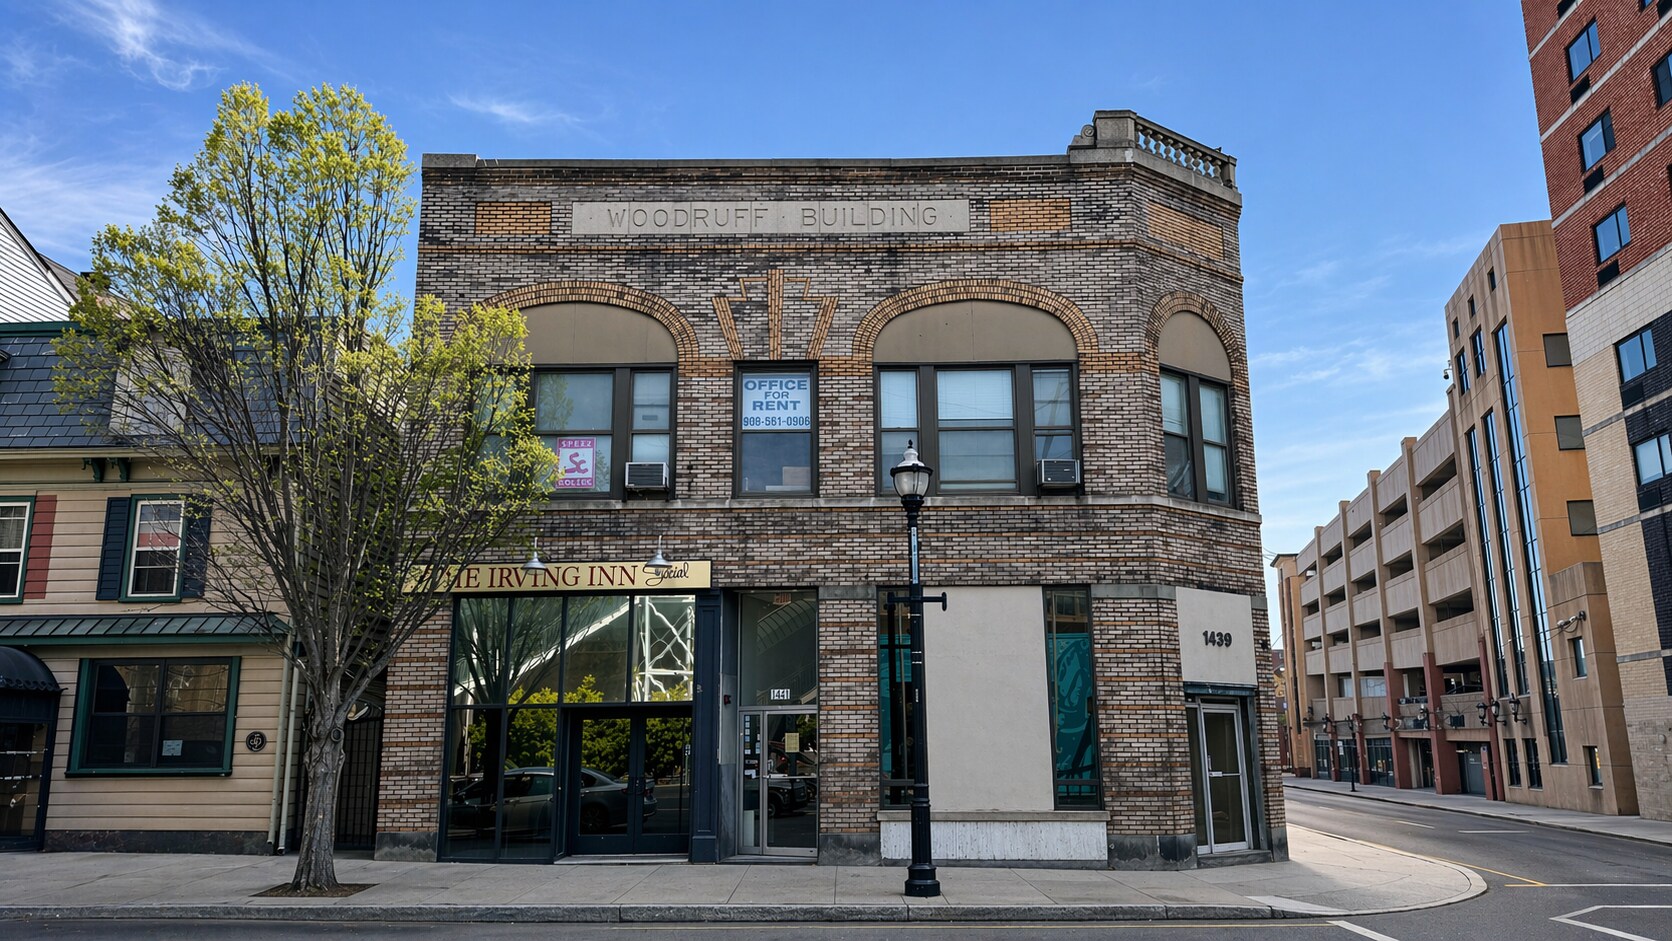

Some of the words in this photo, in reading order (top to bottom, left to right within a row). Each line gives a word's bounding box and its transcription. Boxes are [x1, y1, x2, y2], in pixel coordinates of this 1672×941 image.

[607, 208, 769, 228] WOODRUFF
[801, 206, 937, 227] BUILDING
[744, 379, 808, 391] OFFICE
[764, 391, 790, 400] FOR
[752, 400, 801, 411] RENT
[487, 565, 581, 589] IRVING
[587, 564, 639, 587] INN
[1202, 630, 1233, 648] 1439
[771, 688, 790, 700] 1441
